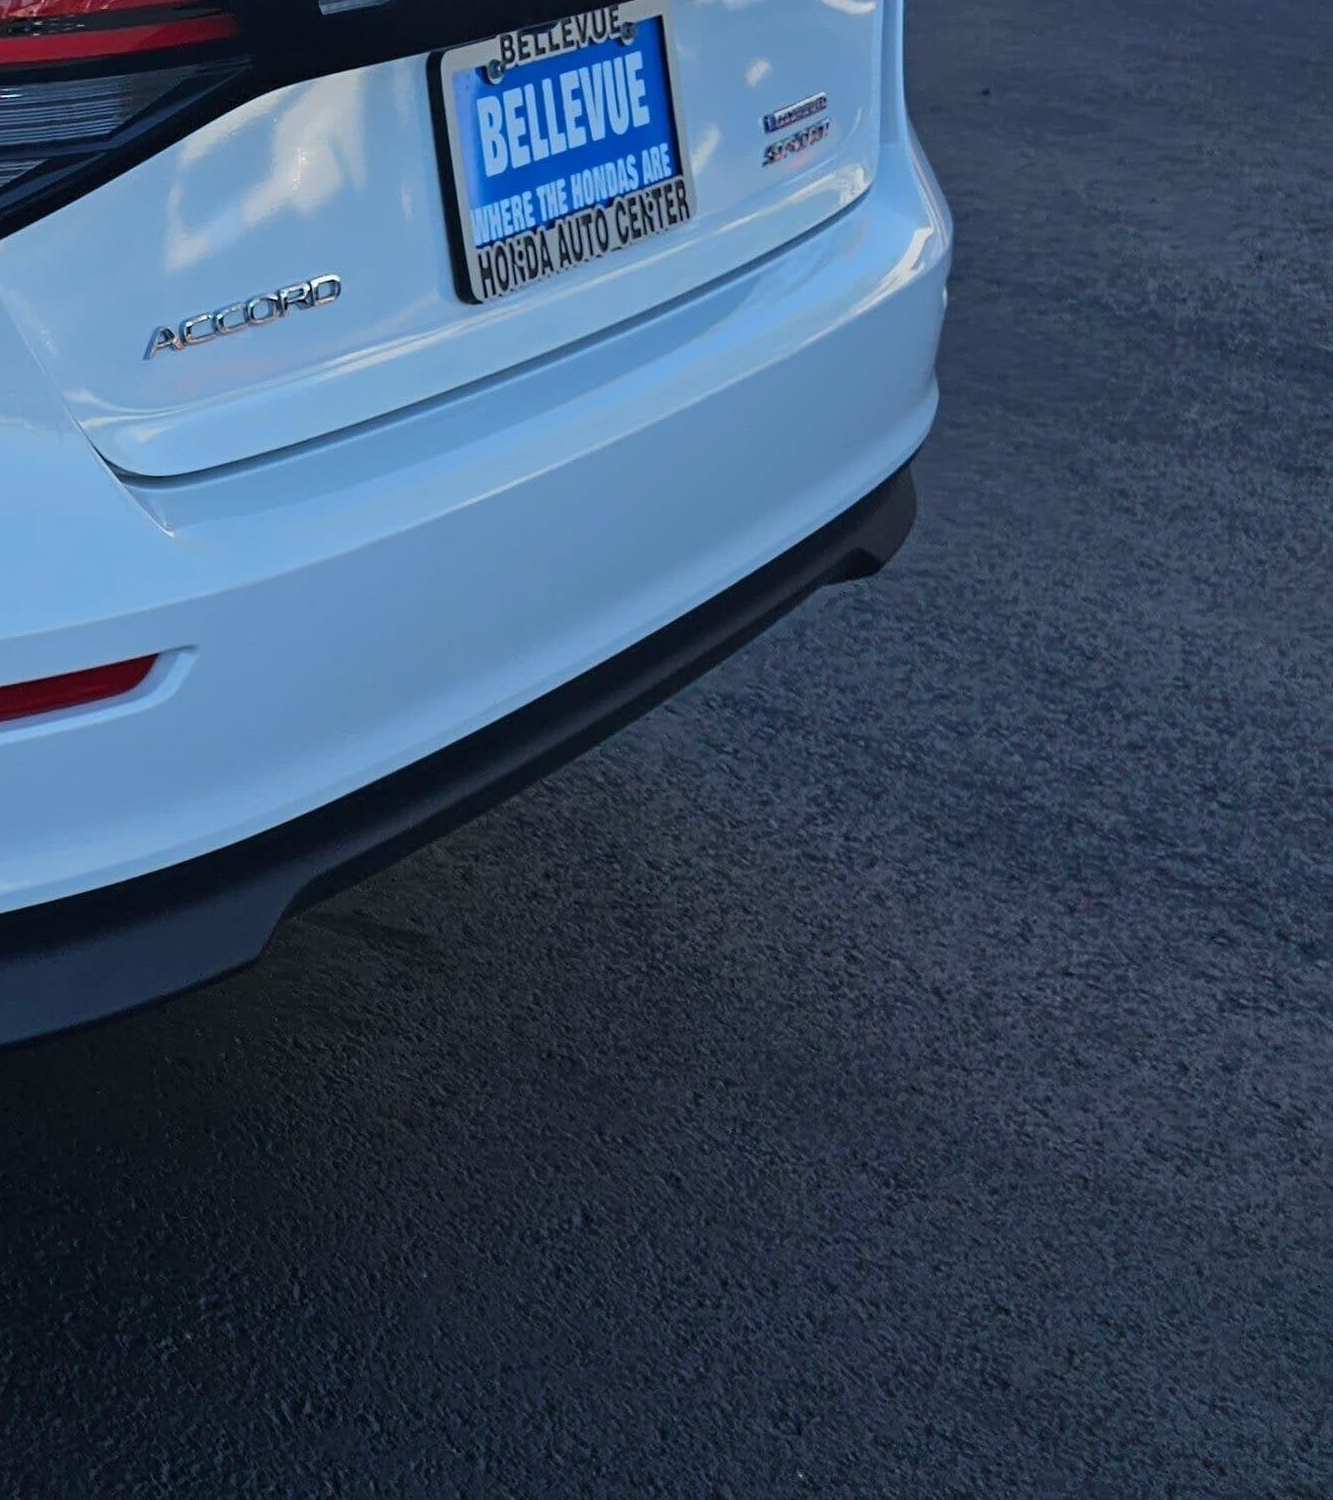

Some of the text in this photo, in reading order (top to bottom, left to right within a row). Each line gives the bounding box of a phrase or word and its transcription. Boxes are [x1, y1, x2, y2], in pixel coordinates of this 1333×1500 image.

[500, 4, 621, 66] BELLEVUE
[476, 51, 650, 177] BELLEVUE
[471, 143, 672, 246] WHERE THE HONDAS ARE
[478, 179, 691, 298] HONDA AUTO CENTER
[143, 274, 341, 360] ACCORD
